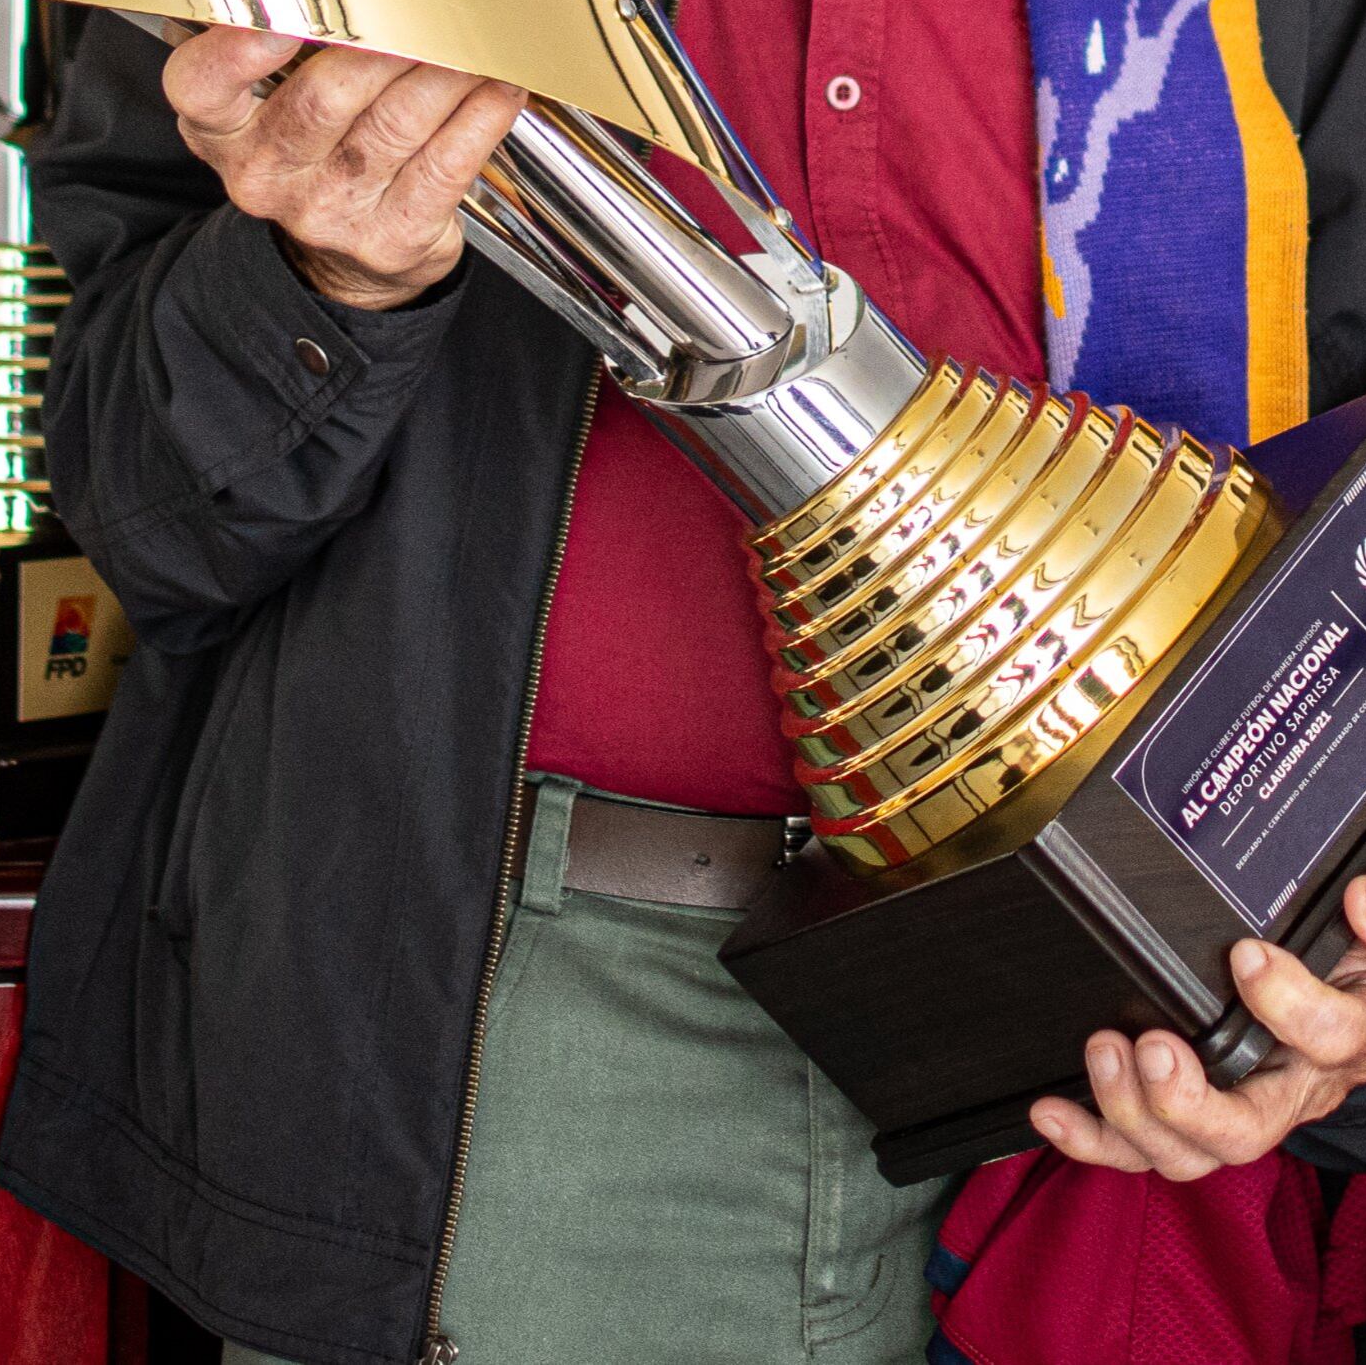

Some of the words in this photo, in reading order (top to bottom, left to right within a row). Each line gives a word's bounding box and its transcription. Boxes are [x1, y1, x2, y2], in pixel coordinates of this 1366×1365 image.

[44, 657, 87, 681] FPD
[1181, 767, 1203, 793] UNIÓN
[1200, 756, 1212, 769] DE
[1210, 729, 1233, 758] CLUBES
[1231, 718, 1243, 731] DE
[1239, 692, 1265, 720] FÚTBOL
[1262, 680, 1273, 692] DE
[1271, 650, 1297, 681] PRIMERA
[1294, 618, 1322, 651] DIVISIÓN
[1181, 799, 1207, 828] AL
[1200, 707, 1276, 801] CAMPEÓN
[1268, 621, 1348, 715] NACIONAL
[1218, 731, 1286, 816] DEPORTIVO
[1285, 666, 1340, 731] SAPRISSA
[1235, 836, 1262, 870] DEDICADO
[1261, 828, 1269, 838] AL
[1267, 789, 1299, 828] CENTENARIO
[1297, 777, 1309, 790] DEL
[1326, 721, 1352, 754] FEDERADO
[1351, 712, 1360, 723] DE
[1258, 738, 1310, 799] CLAUSURA
[1304, 710, 1331, 741] 2021
